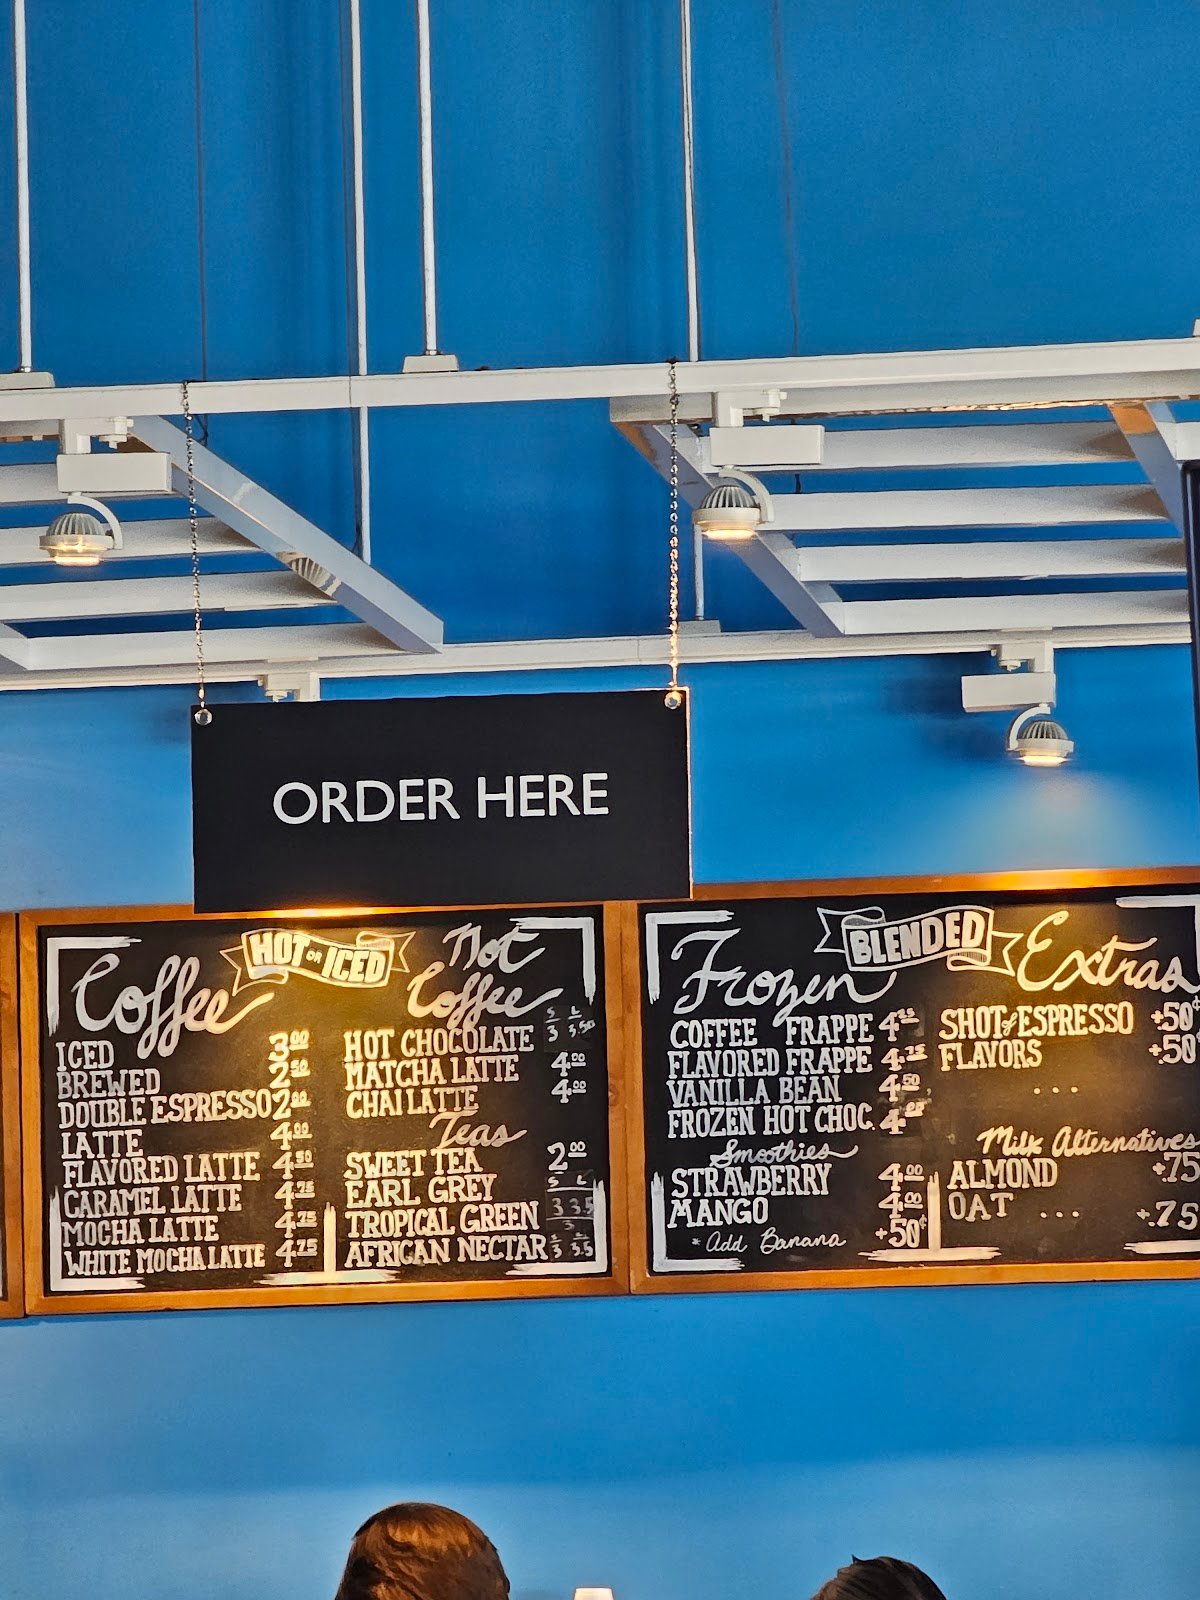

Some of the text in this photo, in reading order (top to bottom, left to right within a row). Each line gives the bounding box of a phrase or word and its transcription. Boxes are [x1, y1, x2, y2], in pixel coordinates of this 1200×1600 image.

[272, 772, 610, 826] ORDER HERE
[442, 922, 546, 974] Not
[850, 910, 986, 965] BLENDED
[1016, 910, 1200, 993] Extras
[249, 931, 311, 967] HOT
[321, 945, 387, 983] ICED
[407, 961, 564, 1030] Coffee
[670, 928, 898, 1028] Frozen
[71, 953, 275, 1060] Coffee
[938, 1005, 1007, 1041] SHOT
[1016, 1001, 1135, 1038] ESPRESSO
[343, 1028, 395, 1062] HOT
[400, 1024, 535, 1058] CHOCOLATE
[670, 1018, 758, 1049] COFFEE
[785, 1013, 875, 1046] FRAPPE
[55, 1040, 114, 1071] ICED
[344, 1056, 447, 1091] MATCHA
[450, 1054, 519, 1083] LATTE
[667, 1047, 780, 1079] FLAVORED
[785, 1045, 873, 1077] FRAPPE
[938, 1039, 1043, 1072] FLAVORS
[56, 1068, 160, 1100] BREWED
[346, 1089, 404, 1119] CHAI
[406, 1085, 479, 1115] LATTE
[666, 1078, 771, 1108] VANILLA
[778, 1074, 842, 1104] BEAN
[57, 1096, 147, 1129] DOUBLE
[150, 1088, 272, 1124] ESPRESSO
[667, 1106, 756, 1139] FROZEN
[763, 1105, 811, 1137] HOT
[814, 1102, 876, 1133] CHOC.
[61, 1128, 144, 1159] LATTE
[428, 1109, 528, 1149] Teas
[977, 1125, 1200, 1158] Milk Alternatives
[62, 1155, 179, 1189] FLAVORED
[183, 1151, 261, 1182] LATTE
[343, 1149, 427, 1180] SWEET
[431, 1147, 484, 1176] TEA
[709, 1139, 859, 1168] Smoothies
[344, 1177, 421, 1209] EARL
[427, 1173, 497, 1203] GREY
[671, 1163, 833, 1198] STRAWBERRY
[946, 1157, 1058, 1190] ALMOND
[64, 1185, 166, 1219] CARAMEL
[170, 1183, 243, 1213] LATTE
[667, 1197, 769, 1229] MANGO
[948, 1192, 1014, 1222] OAT
[61, 1218, 146, 1248] MOCHA
[148, 1215, 220, 1243] LATTE
[345, 1207, 455, 1239] TROPICAL
[459, 1200, 540, 1233] GREEN
[344, 1237, 451, 1268] AFRICAN
[457, 1233, 549, 1263] NECTAR
[705, 1230, 749, 1253] Add
[760, 1227, 847, 1255] Banana
[64, 1249, 132, 1276] WHITE
[136, 1246, 208, 1274] MOCHA
[207, 1244, 266, 1271] LATTE
